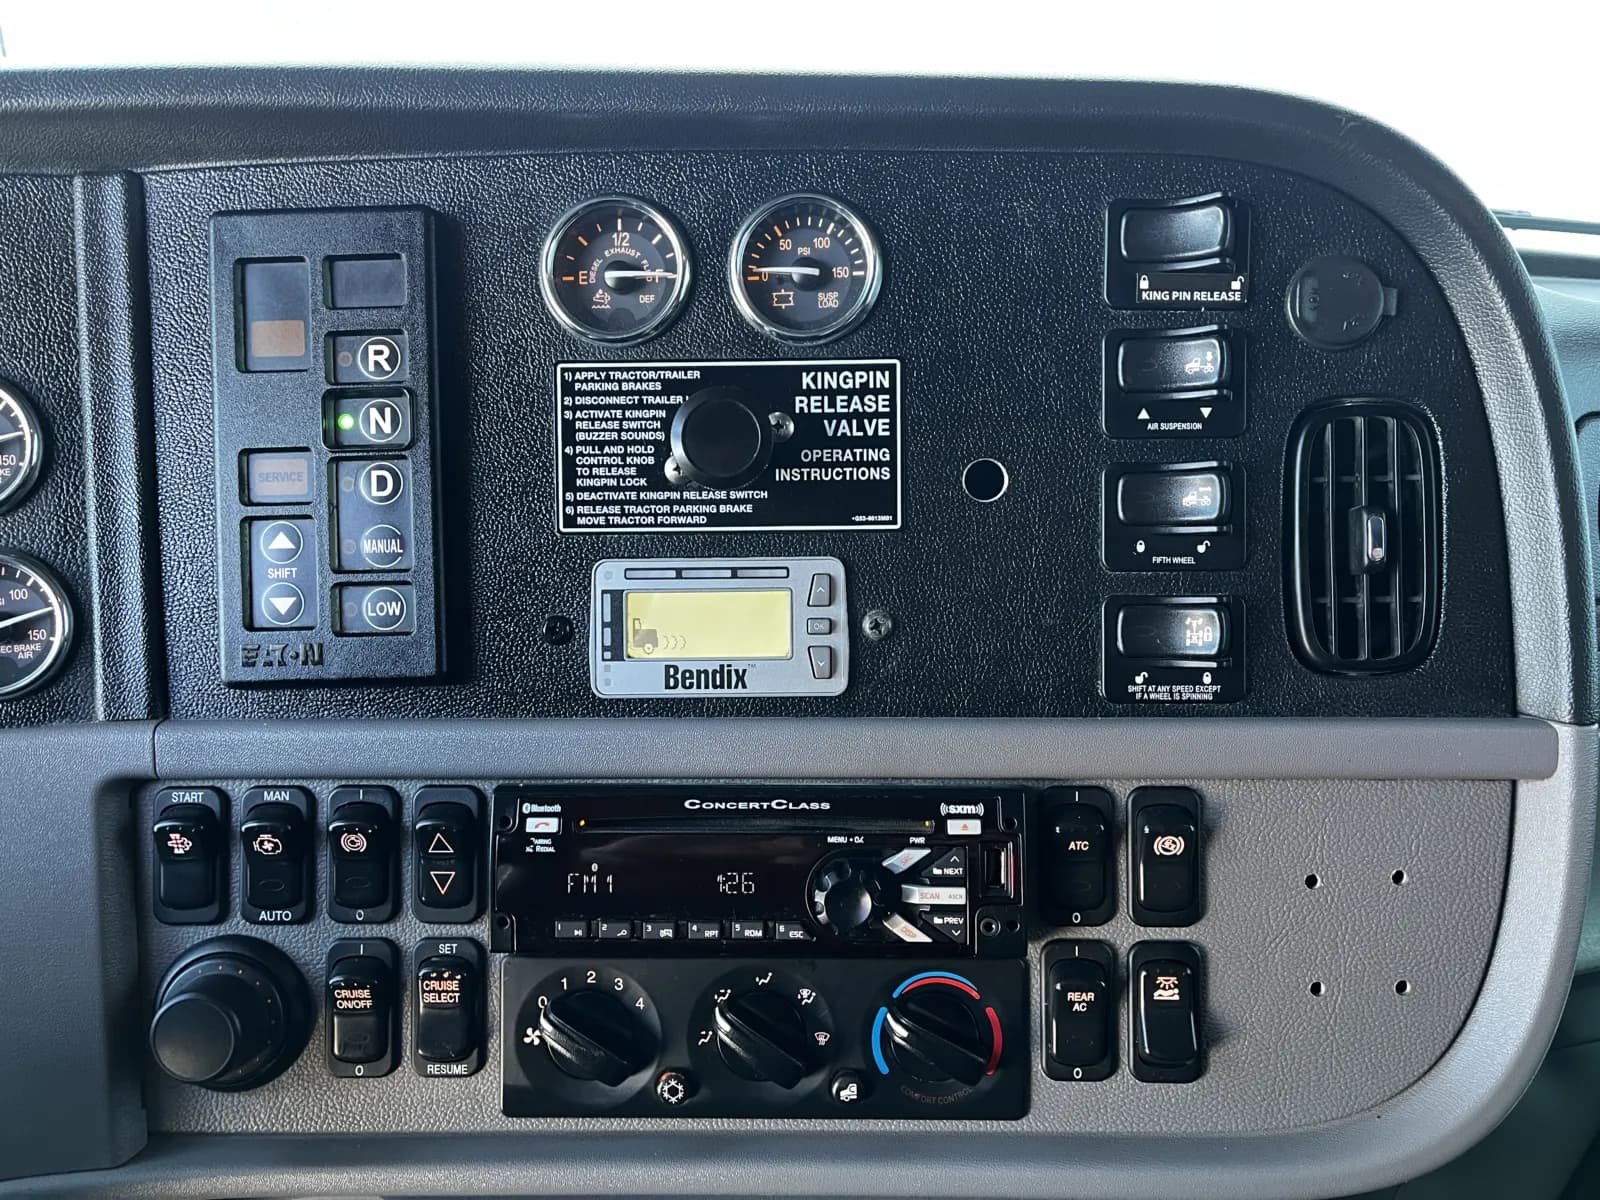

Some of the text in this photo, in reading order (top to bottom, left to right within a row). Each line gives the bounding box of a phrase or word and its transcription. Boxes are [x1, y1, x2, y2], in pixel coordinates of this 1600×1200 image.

[612, 232, 630, 247] 1/2
[779, 239, 792, 251] 50
[813, 237, 831, 249] 100
[604, 247, 641, 259] EXHAUST
[797, 247, 811, 256] PSI
[578, 270, 588, 285] E
[832, 267, 849, 278] 150
[639, 294, 656, 304] DEF
[817, 292, 838, 300] SUSP
[1141, 291, 1242, 301] KING PIN RELEASE
[818, 299, 839, 308] LOAD
[367, 344, 392, 372] R
[563, 371, 701, 381] 1) APPLY TRACTOR/TRAILER
[801, 370, 890, 390] KINGPIN
[575, 382, 662, 391] PARKING BRAKES
[563, 395, 684, 406] 2) DISCONNECT TRAILER
[795, 394, 891, 414] RELEASE
[368, 406, 392, 434] N
[564, 410, 666, 420] 3) ACTIVATE KINGPIN
[576, 420, 661, 430] RELEASE SWITCH
[823, 418, 891, 437] VALVE
[1147, 422, 1203, 430] AIR SUSPENSION
[576, 431, 665, 442] (BUZZER SOUNDS)
[564, 445, 655, 456] 4) PULL AND HOLD
[800, 448, 891, 462] OPERATING
[576, 456, 655, 465] CONTROL KNOB
[257, 471, 304, 482] SERVICE
[576, 467, 637, 476] TO RELEASE
[775, 466, 891, 481] INSTRUCTIONS
[370, 469, 394, 497] D
[576, 478, 648, 487] KINGPIN LOCK
[565, 490, 768, 501] 5) DEACTIVATE KINGPIN RELEASE SWITCH
[565, 504, 753, 515] 6) RELEASE TRACTOR PARKING BRAKE
[577, 515, 707, 525] MOVE TRACTOR FORWARD
[363, 538, 403, 553] MANUAL
[1152, 556, 1196, 565] FIFTH WHEEL
[267, 567, 298, 579] SHIFT
[9, 588, 28, 601] 100
[367, 601, 401, 617] LOW
[27, 629, 47, 641] 150
[0, 643, 41, 654] EC BRAKE
[18, 651, 33, 660] AIR
[664, 663, 748, 690] Bendix
[1127, 685, 1222, 693] SHIFT AT ANY SPEED EXCEPT
[171, 791, 204, 803] START
[263, 791, 290, 801] MAN
[530, 803, 562, 813] Bluetooth
[827, 836, 847, 844] MENU
[1068, 841, 1090, 851] ATC
[943, 867, 964, 875] NEXT
[567, 873, 597, 894] FM
[717, 872, 755, 894] 1:26
[259, 910, 292, 921] AUTO
[943, 917, 964, 925] PREV
[646, 924, 652, 932] 3
[691, 924, 719, 938] 4 RPT
[735, 924, 741, 932] 5
[438, 943, 458, 954] SET
[586, 970, 596, 984] 2
[423, 980, 460, 991] CRUISE
[560, 977, 568, 991] 1
[614, 977, 624, 991] 3
[334, 989, 372, 999] CRUISE
[423, 992, 460, 1003] SELECT
[1067, 992, 1095, 1002] REAR
[336, 1000, 373, 1009] ON/OFF
[538, 995, 548, 1009] 0
[635, 997, 645, 1010] 4
[1072, 1003, 1088, 1012] AC
[427, 1064, 468, 1075] RESUME
